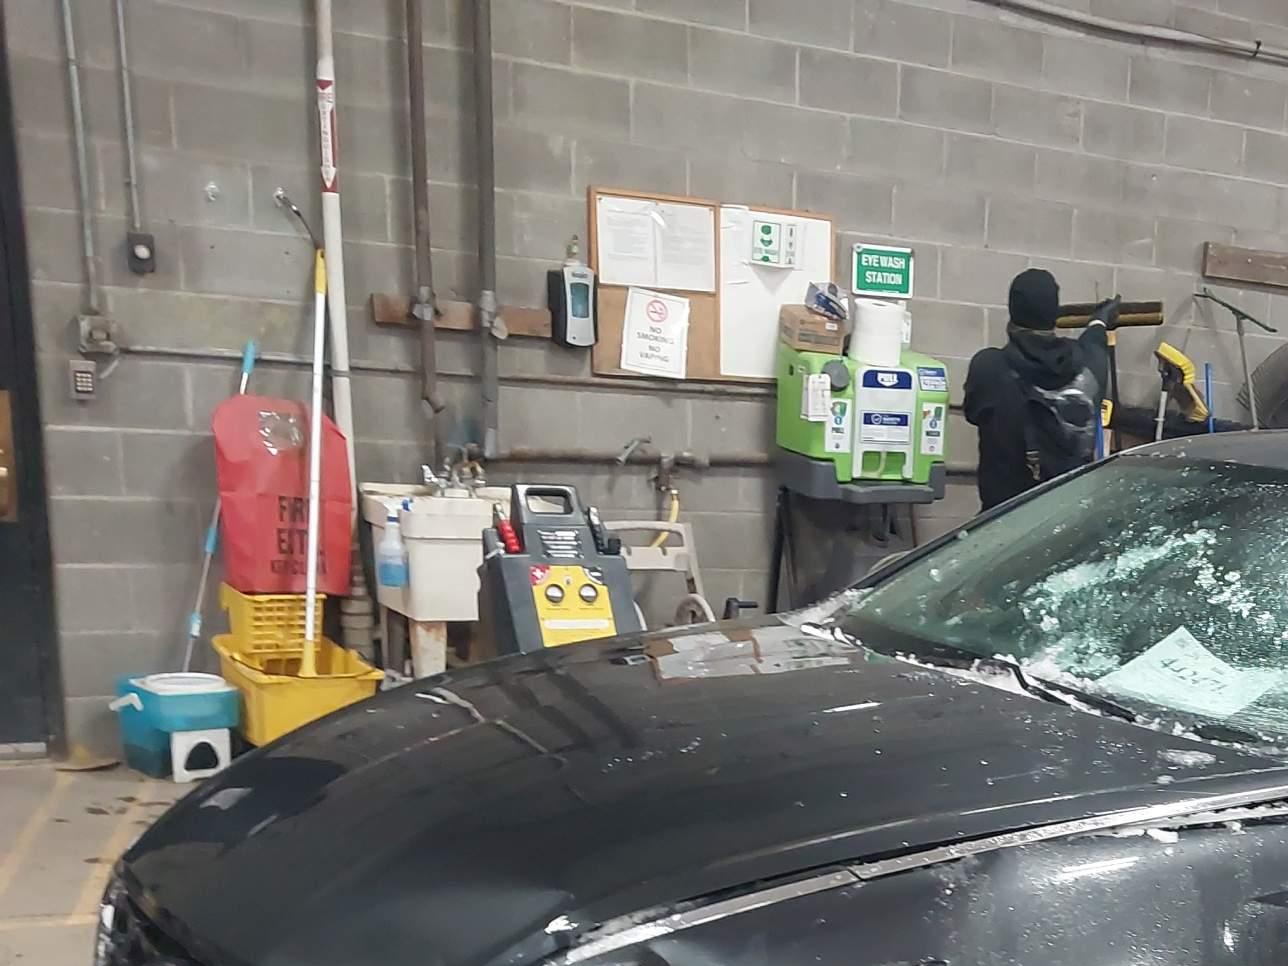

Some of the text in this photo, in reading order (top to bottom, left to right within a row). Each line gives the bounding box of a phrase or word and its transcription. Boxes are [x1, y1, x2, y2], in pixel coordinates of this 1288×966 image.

[861, 253, 906, 270] EYE WASH
[865, 270, 903, 285] STATION
[649, 326, 662, 334] NO
[636, 331, 675, 345] SMOKING
[648, 345, 661, 353] NO
